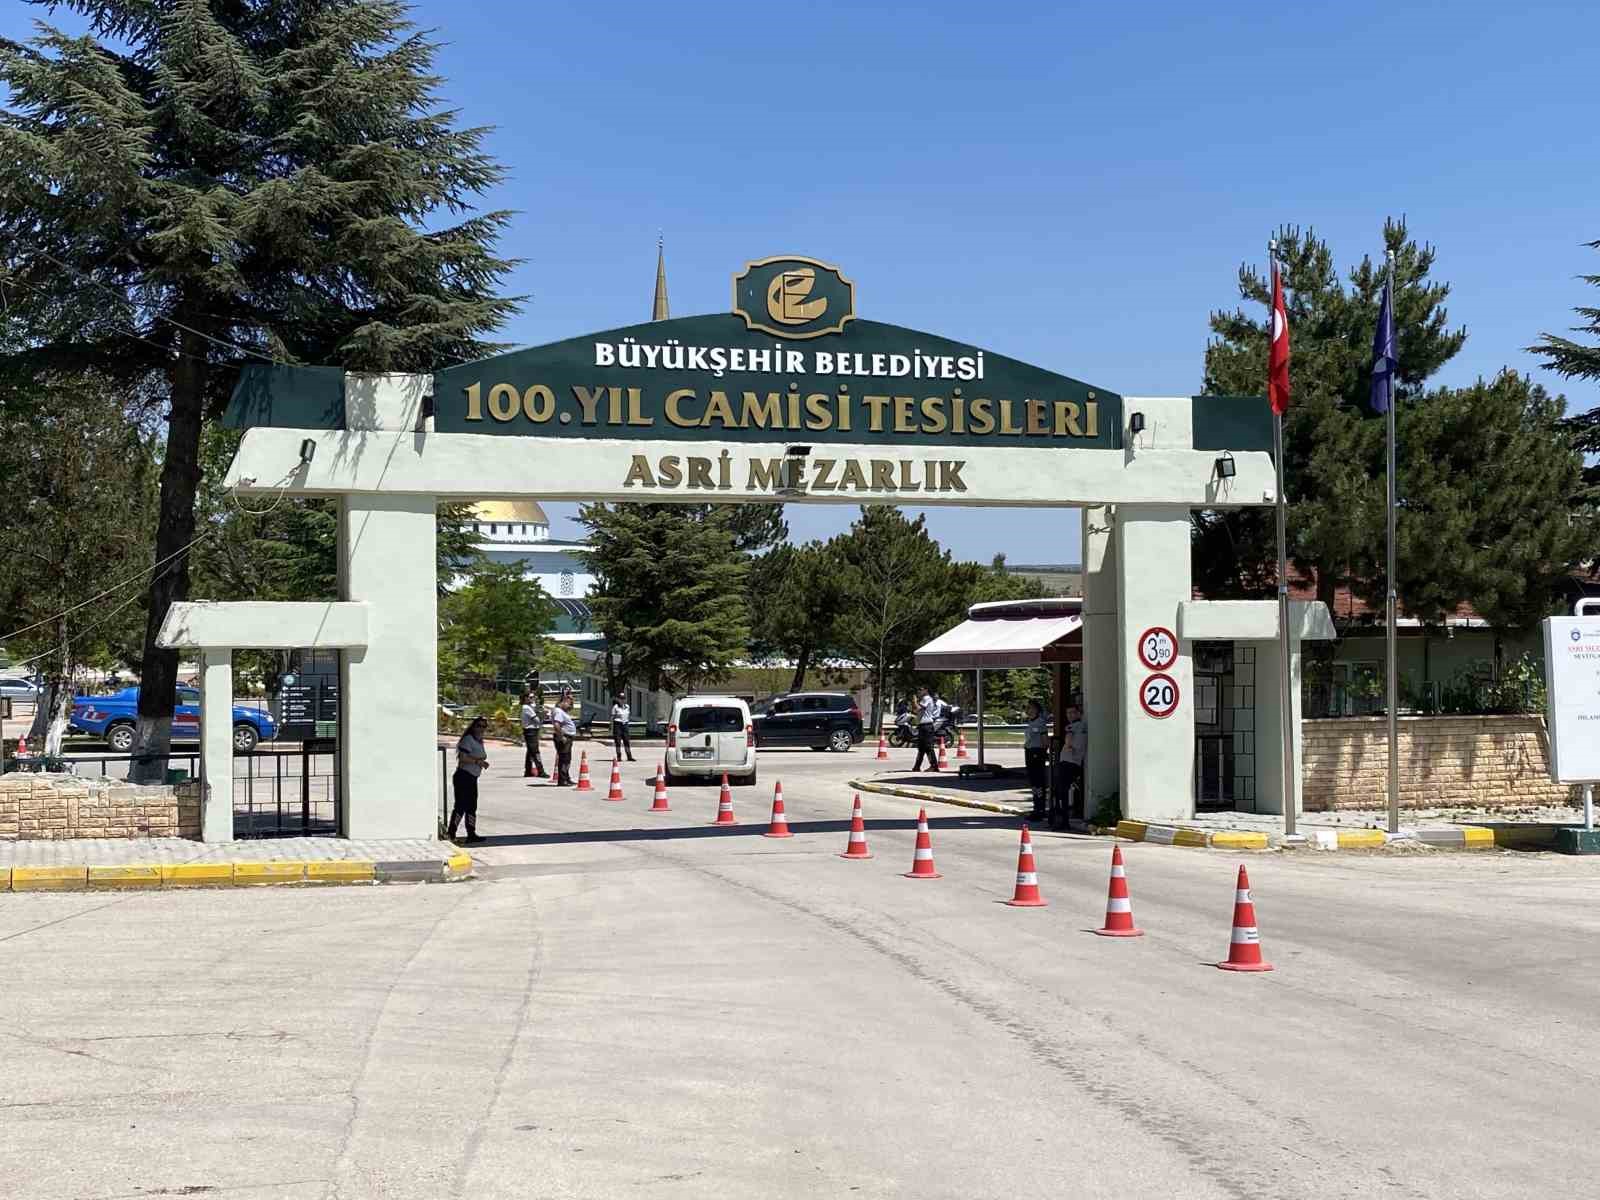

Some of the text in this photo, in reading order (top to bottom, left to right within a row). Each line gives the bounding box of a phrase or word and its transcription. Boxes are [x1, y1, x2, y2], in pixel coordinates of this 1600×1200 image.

[594, 336, 984, 381] BÜYÜKŞEHİR BELEDİYESİ
[664, 382, 851, 431] CAMİSİ
[861, 387, 1099, 437] TESİSLERİ
[623, 449, 969, 493] ASRİ MEZARLIK
[1147, 685, 1174, 706] 20
